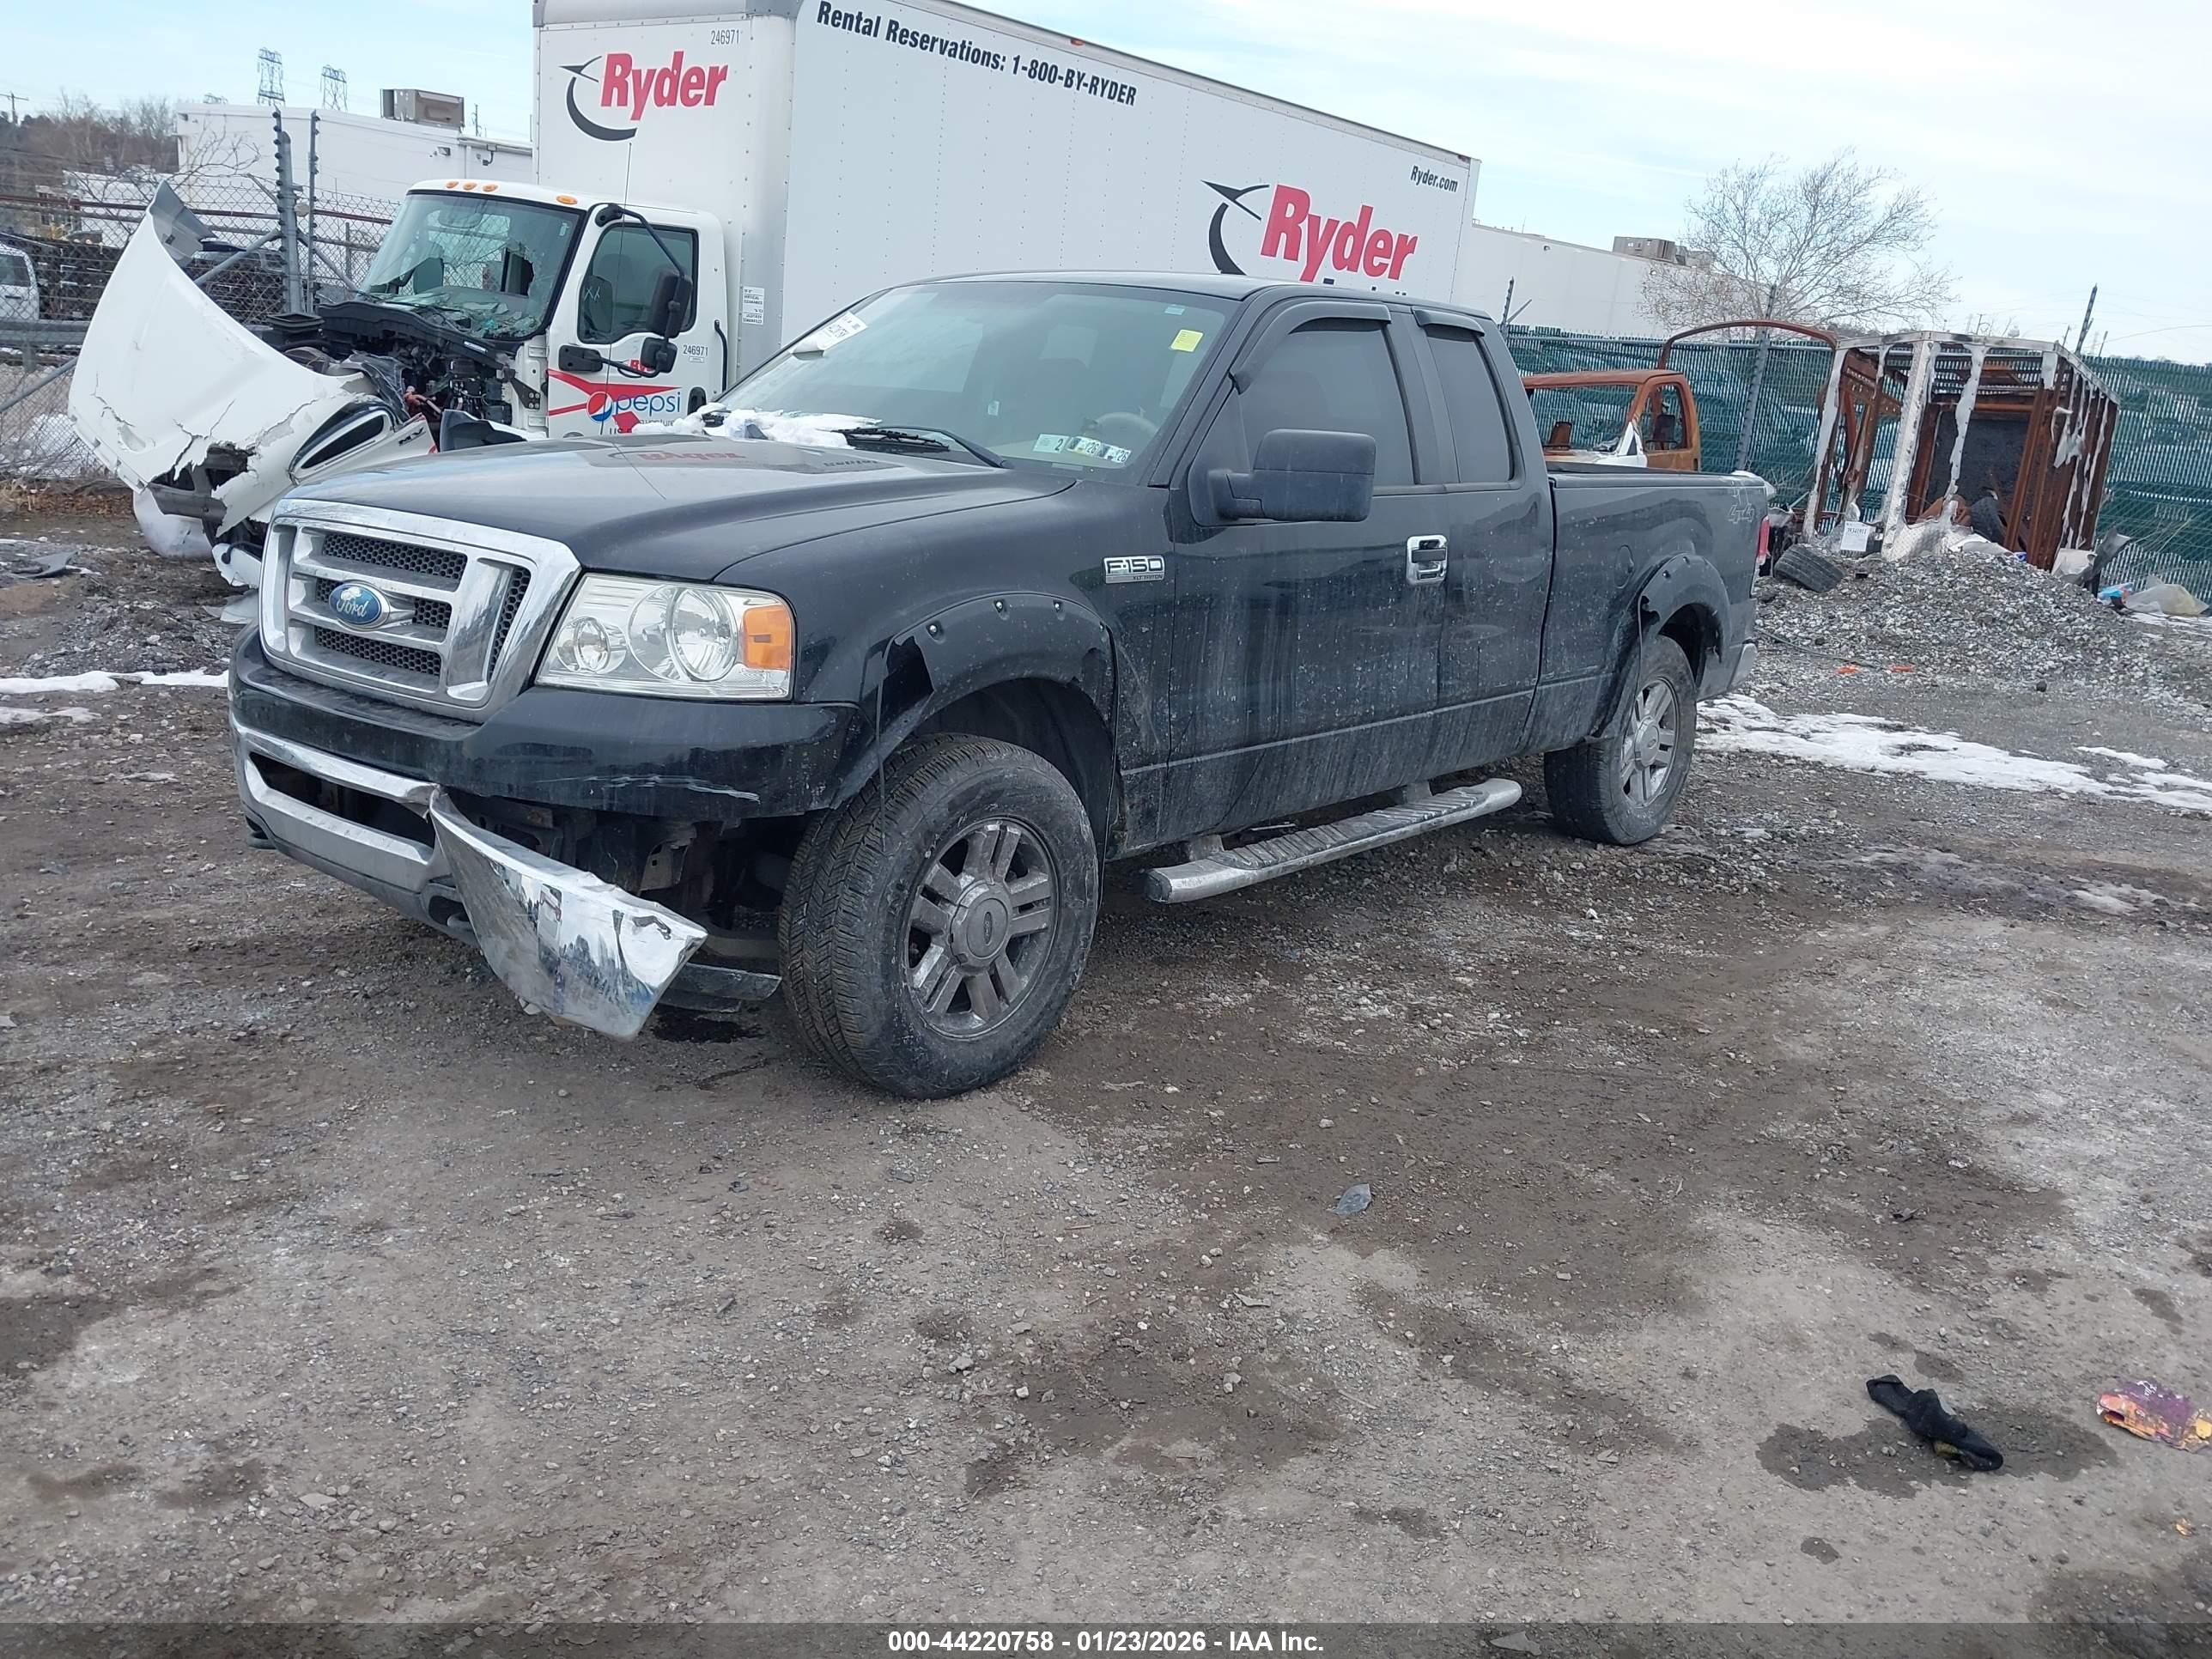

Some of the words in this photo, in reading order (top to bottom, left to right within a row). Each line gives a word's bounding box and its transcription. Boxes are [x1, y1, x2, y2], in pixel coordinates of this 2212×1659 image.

[711, 29, 739, 46] 246971
[817, 1, 881, 38] Rental
[885, 19, 1006, 71] Reservations:
[1012, 55, 1137, 106] 1-800-BY-RYDER
[600, 51, 728, 121] Ryder
[1410, 165, 1458, 193] Ryder.com
[1260, 183, 1419, 283] Ryder
[683, 344, 708, 356] 246971
[615, 392, 681, 416] pepsi
